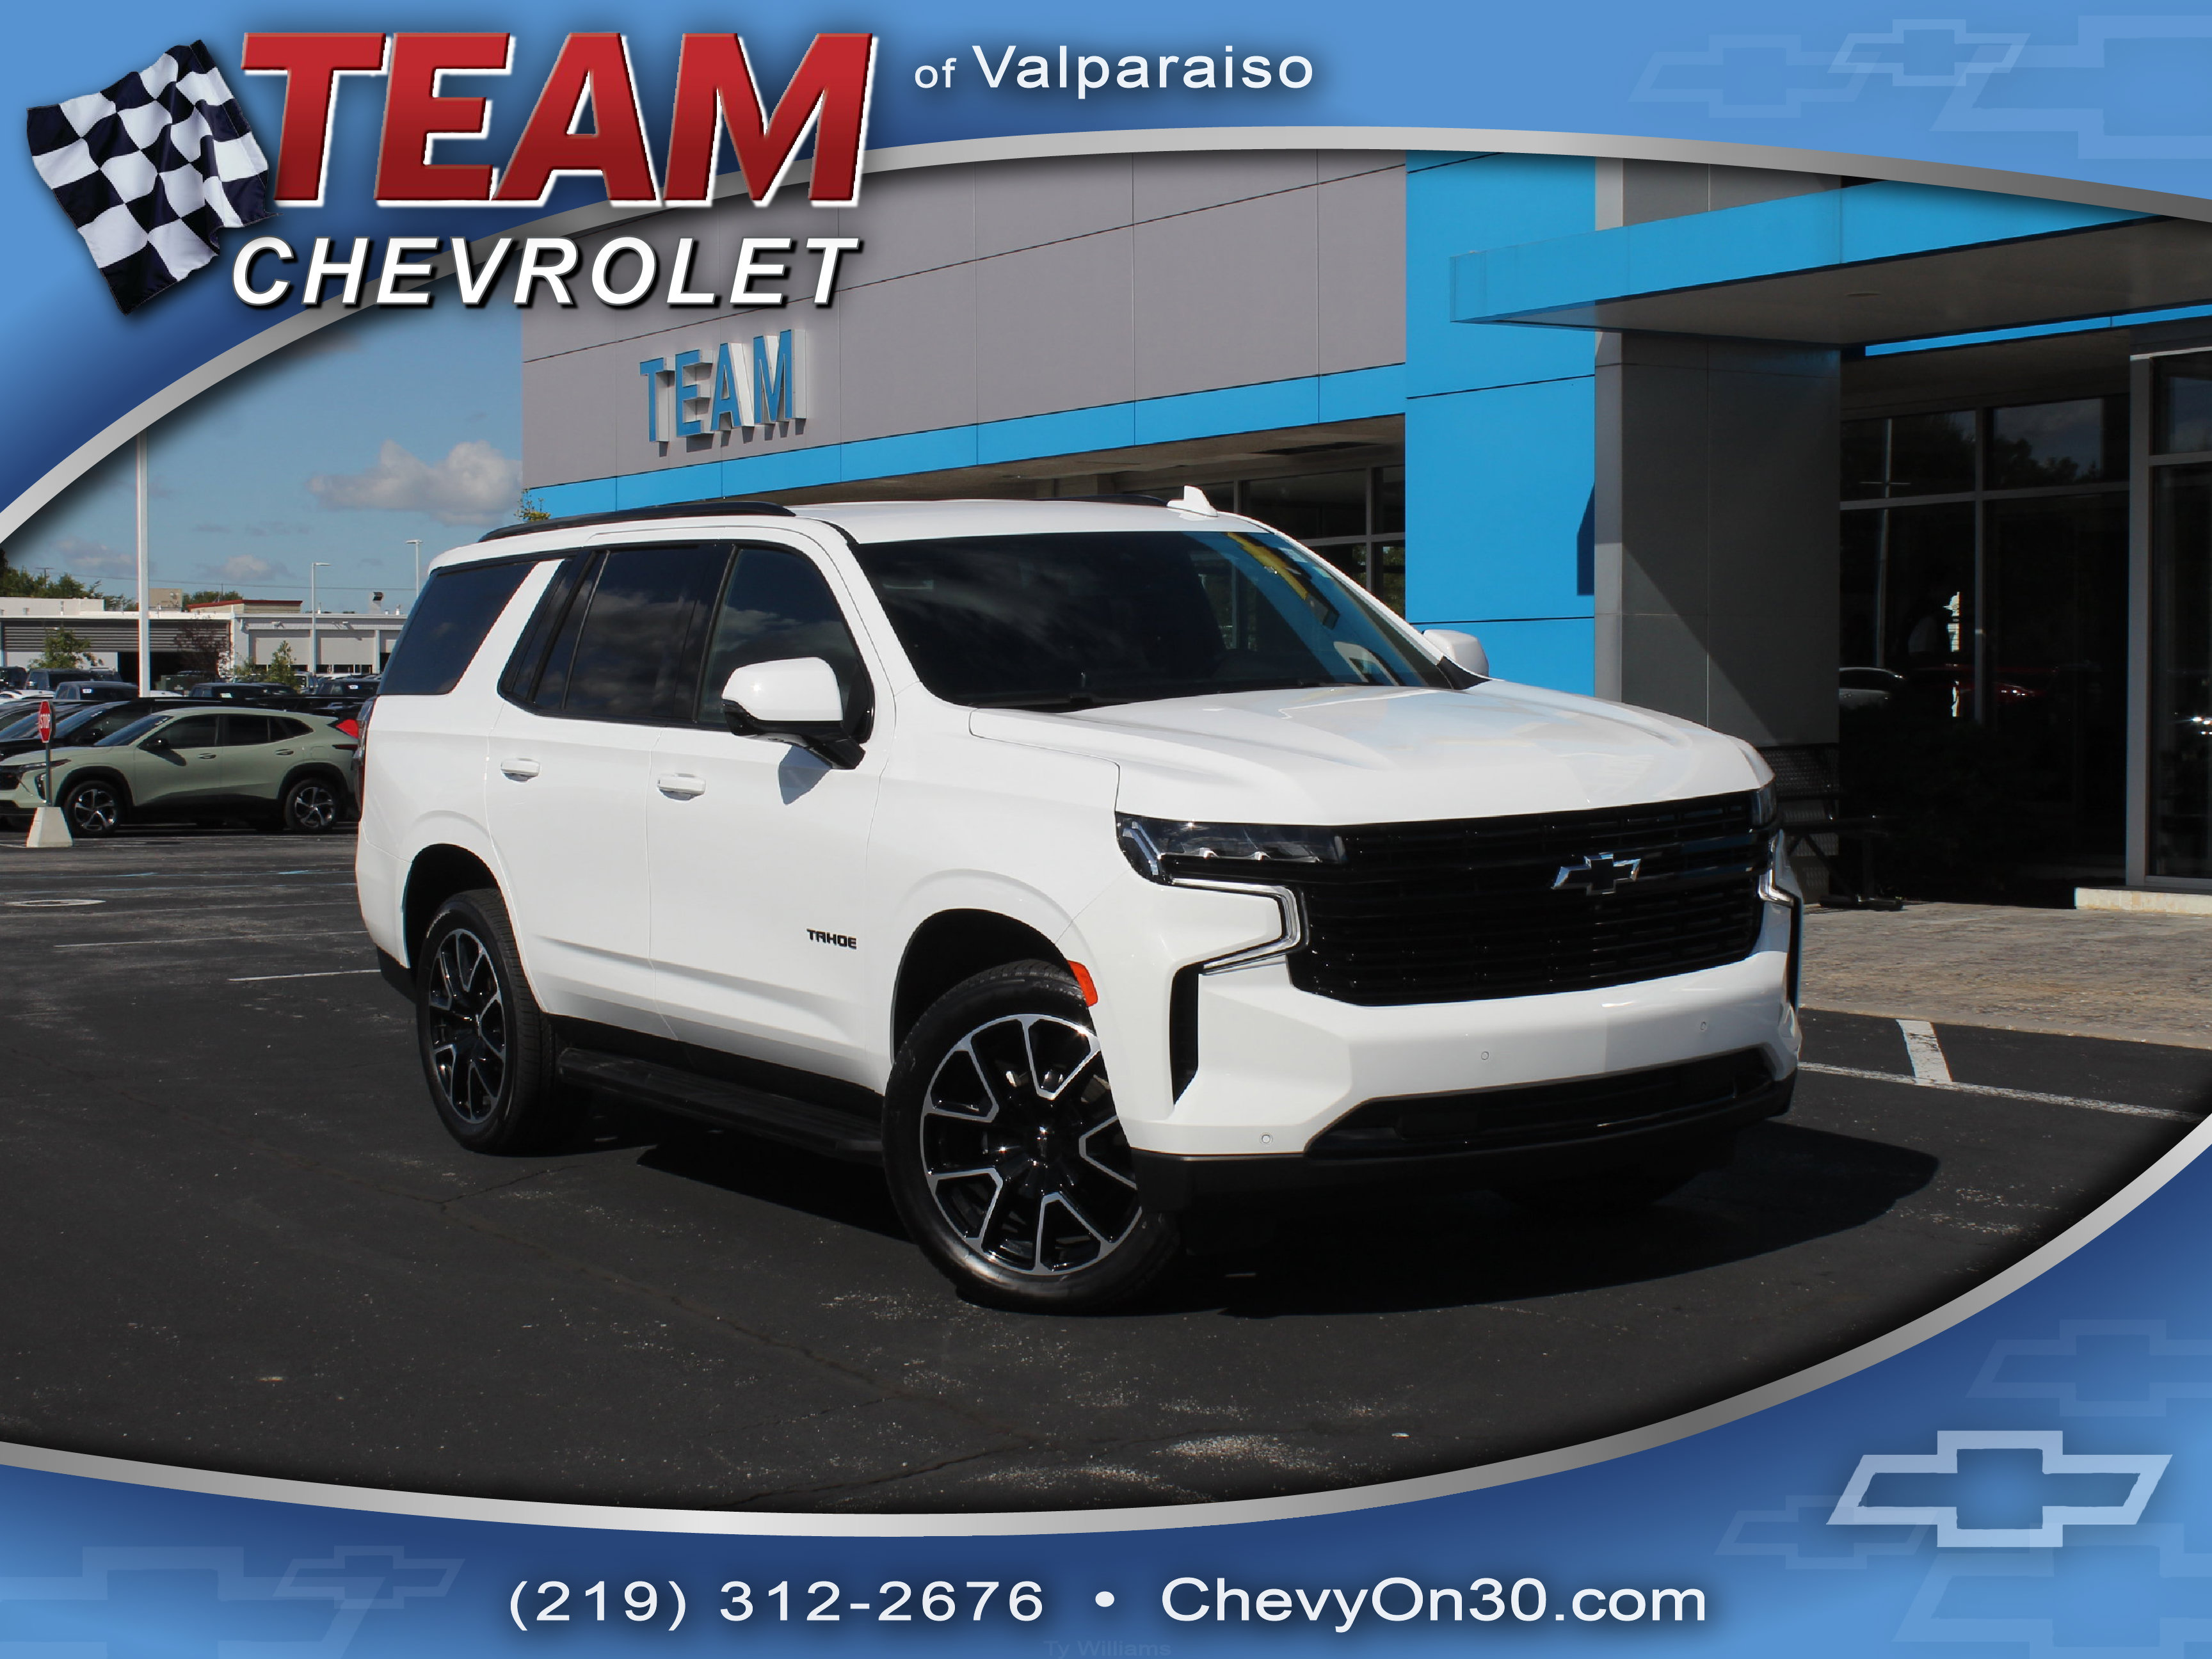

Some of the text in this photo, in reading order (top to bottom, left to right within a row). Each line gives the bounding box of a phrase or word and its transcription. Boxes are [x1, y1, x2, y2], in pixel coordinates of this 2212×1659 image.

[639, 328, 805, 443] TEAM
[40, 713, 51, 729] STOP
[806, 928, 857, 950] TAHOE
